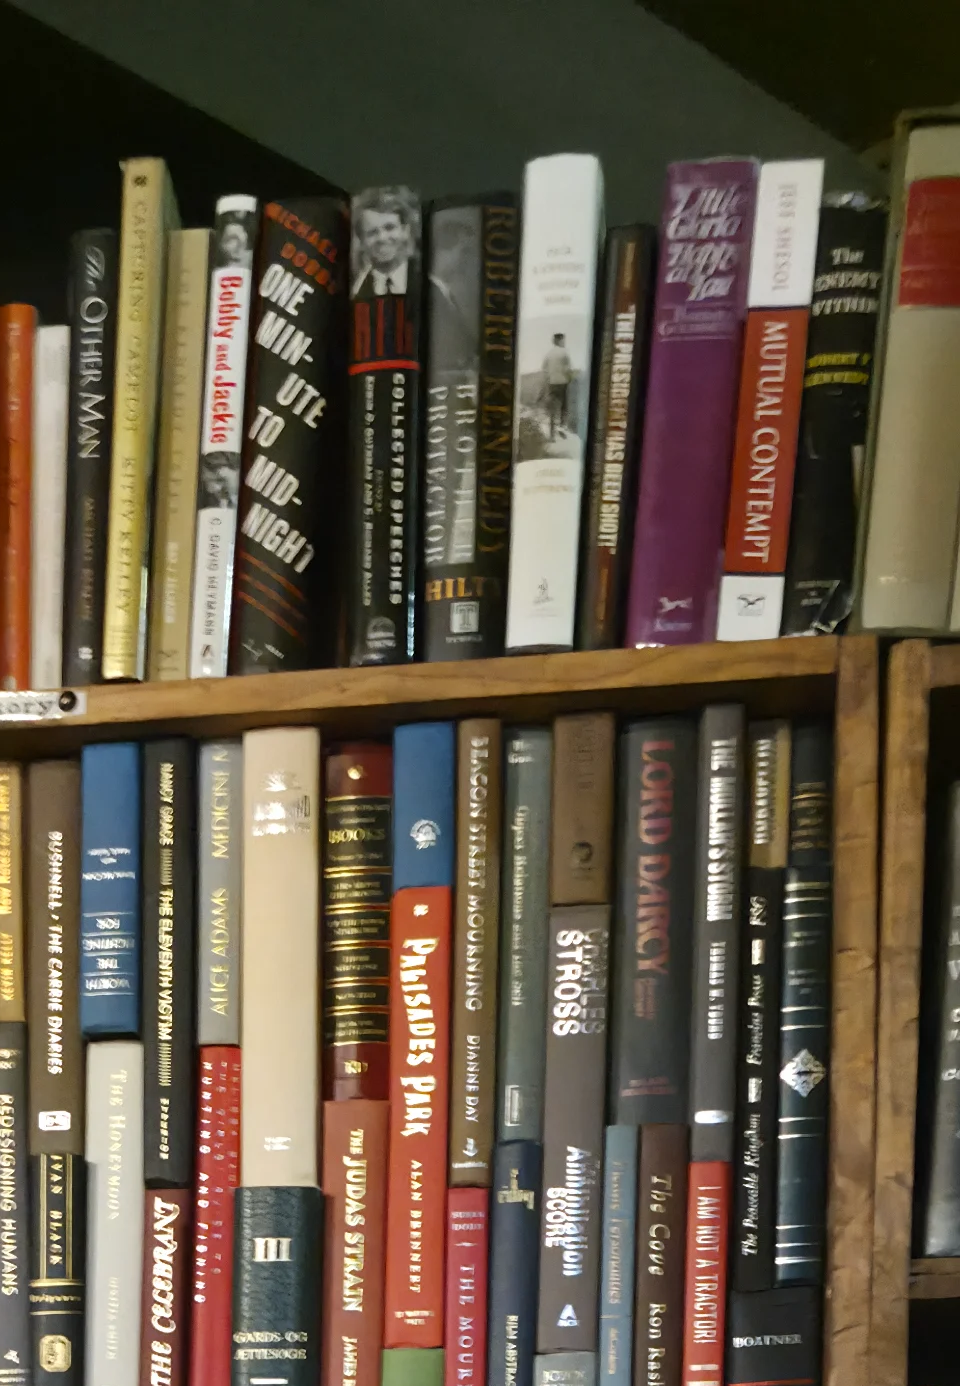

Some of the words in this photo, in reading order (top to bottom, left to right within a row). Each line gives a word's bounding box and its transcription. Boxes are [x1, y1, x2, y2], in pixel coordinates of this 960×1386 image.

[220, 276, 243, 340] Bobby
[259, 265, 314, 315] ONE
[80, 299, 108, 386] OTHER
[217, 345, 231, 371] and
[255, 320, 313, 364] MIN-
[749, 321, 788, 420] MUTUAL
[77, 397, 105, 457] MAN
[211, 372, 237, 445] Jackie
[250, 408, 280, 446] TO
[277, 374, 326, 427] UTE
[391, 373, 405, 496] COLLECTED
[247, 456, 303, 505] MID-
[744, 427, 781, 562] CONTEMPT
[242, 505, 315, 572] NIGHT
[389, 502, 403, 604] SPEECHES
[469, 736, 490, 818] BEACON
[642, 739, 675, 844] LORD
[47, 830, 63, 909] BUSHNELL
[468, 822, 487, 890] STREET
[158, 888, 173, 917] THE
[635, 853, 670, 976] DARCY
[47, 925, 62, 954] THE
[158, 919, 173, 987] ELEVENTH
[465, 895, 486, 1012] MOURNING
[46, 957, 62, 1011] CARRIE
[157, 989, 173, 1041] VICTIM
[400, 938, 440, 1067] PALISADES
[553, 929, 583, 1037] STROSS
[46, 1015, 62, 1075] DIARIES
[400, 1078, 435, 1138] PARK
[343, 1157, 367, 1227] JUDAS
[650, 1174, 672, 1212] The
[699, 1197, 721, 1218] AM
[151, 1196, 180, 1333] CELEBRANT
[649, 1222, 670, 1277] Cove
[697, 1224, 721, 1256] NOT
[697, 1260, 718, 1269] A
[343, 1232, 366, 1313] STRAIN
[459, 1264, 474, 1306] THE
[648, 1303, 667, 1339] Ron
[693, 1273, 718, 1344] TRACTOR!
